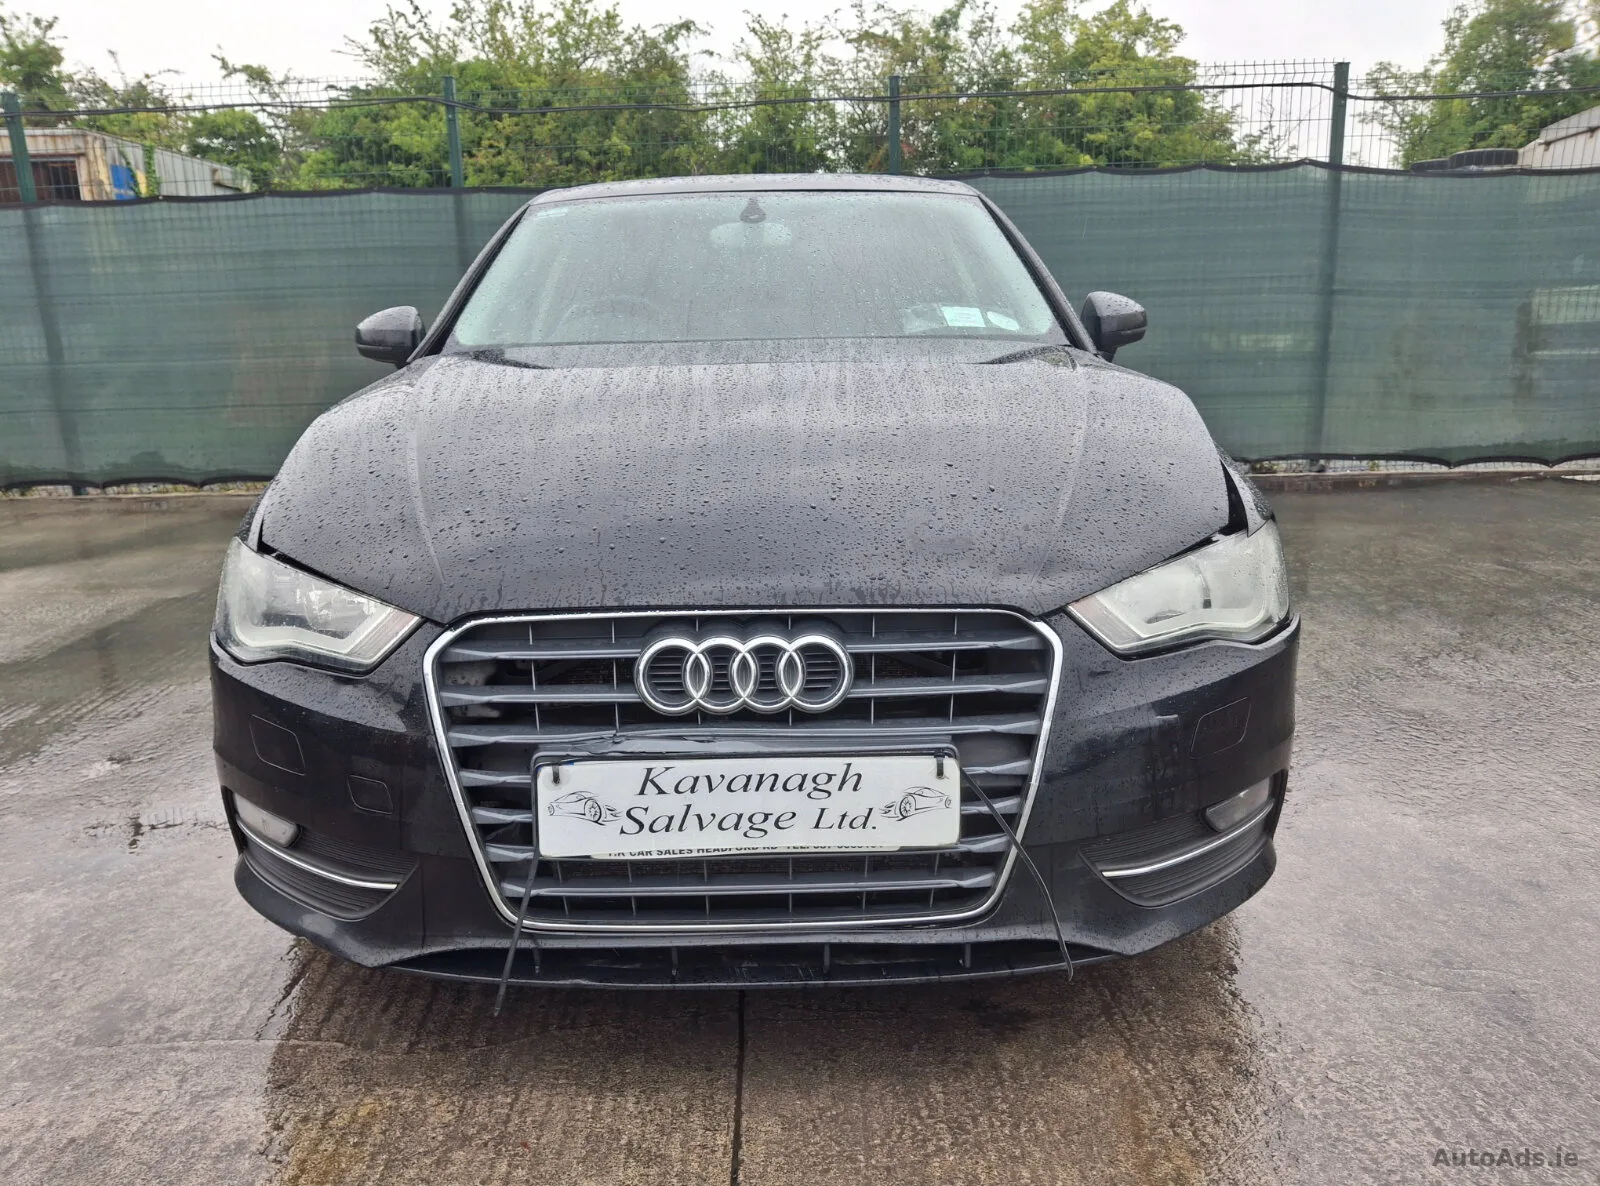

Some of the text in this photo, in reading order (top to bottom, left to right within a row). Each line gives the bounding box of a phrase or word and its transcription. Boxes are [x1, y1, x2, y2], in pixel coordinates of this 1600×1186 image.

[636, 762, 863, 800] Kavanagh
[618, 804, 878, 839] Salvage Ltd.
[656, 848, 693, 856] SALES
